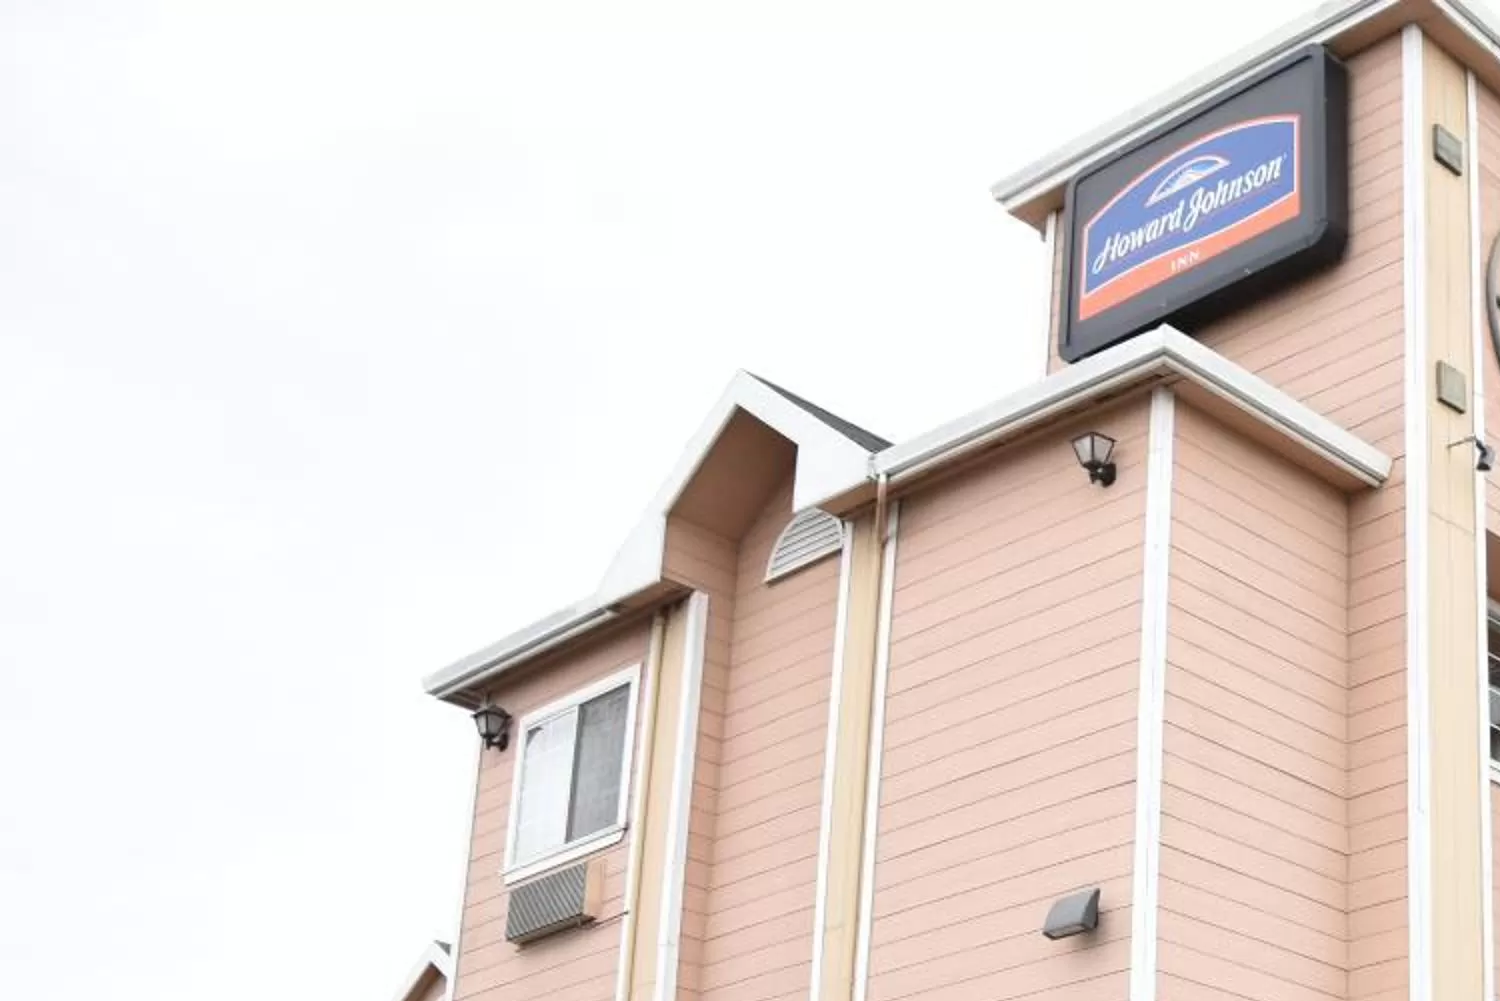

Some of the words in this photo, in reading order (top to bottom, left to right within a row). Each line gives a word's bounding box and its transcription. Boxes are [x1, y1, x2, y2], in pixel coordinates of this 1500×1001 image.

[1091, 199, 1185, 275] Howard
[1183, 156, 1283, 233] Johnson
[1170, 250, 1200, 272] INN
